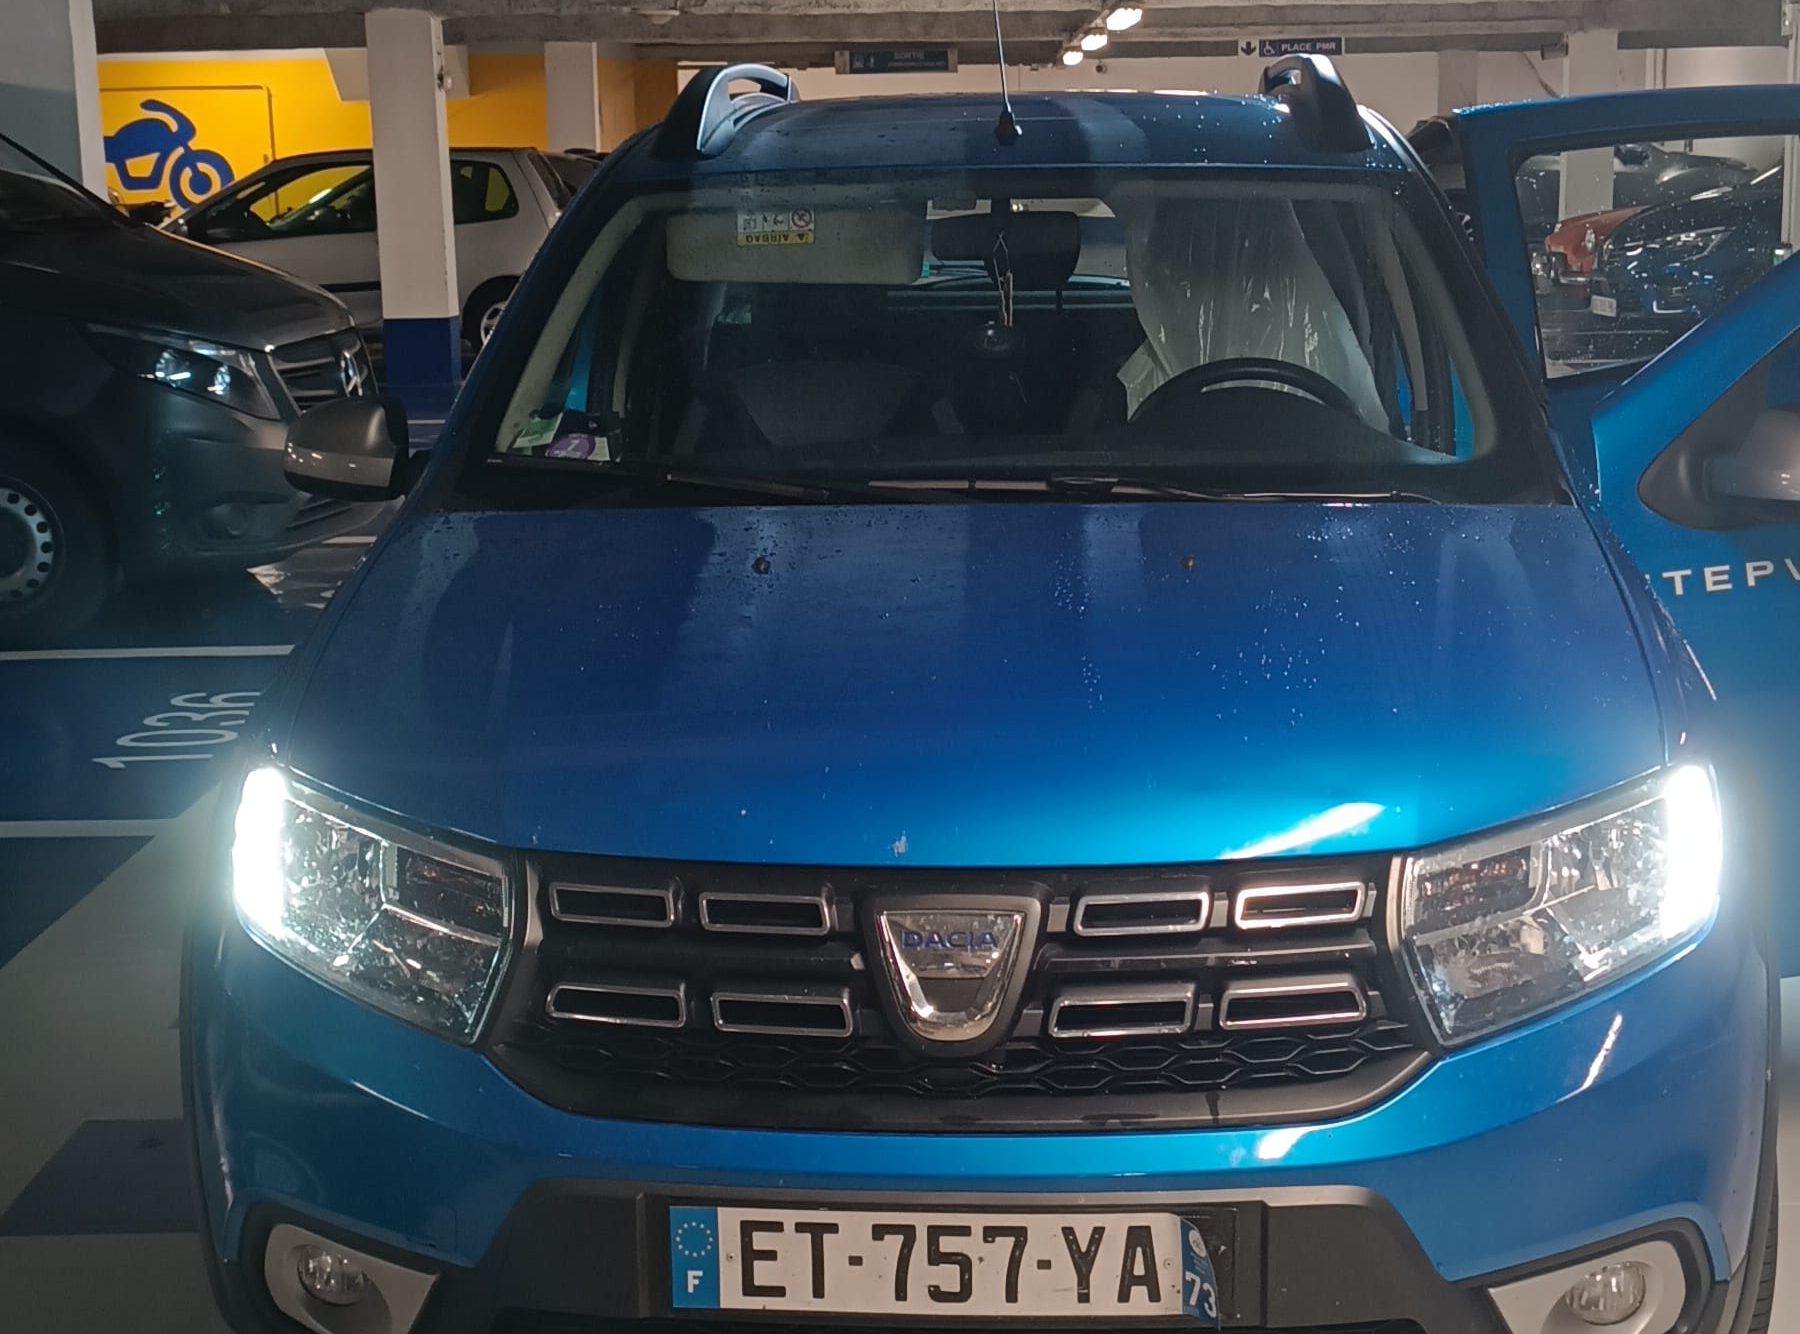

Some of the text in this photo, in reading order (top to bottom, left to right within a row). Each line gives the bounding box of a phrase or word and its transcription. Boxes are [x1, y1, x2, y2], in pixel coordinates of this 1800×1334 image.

[1281, 42, 1337, 52] PLACE PMR
[1645, 557, 1800, 596] TEPV
[902, 931, 999, 951] DACIA
[739, 1219, 1162, 1304] ET-757-YA
[687, 1269, 704, 1294] F
[1185, 1270, 1217, 1319] 73
